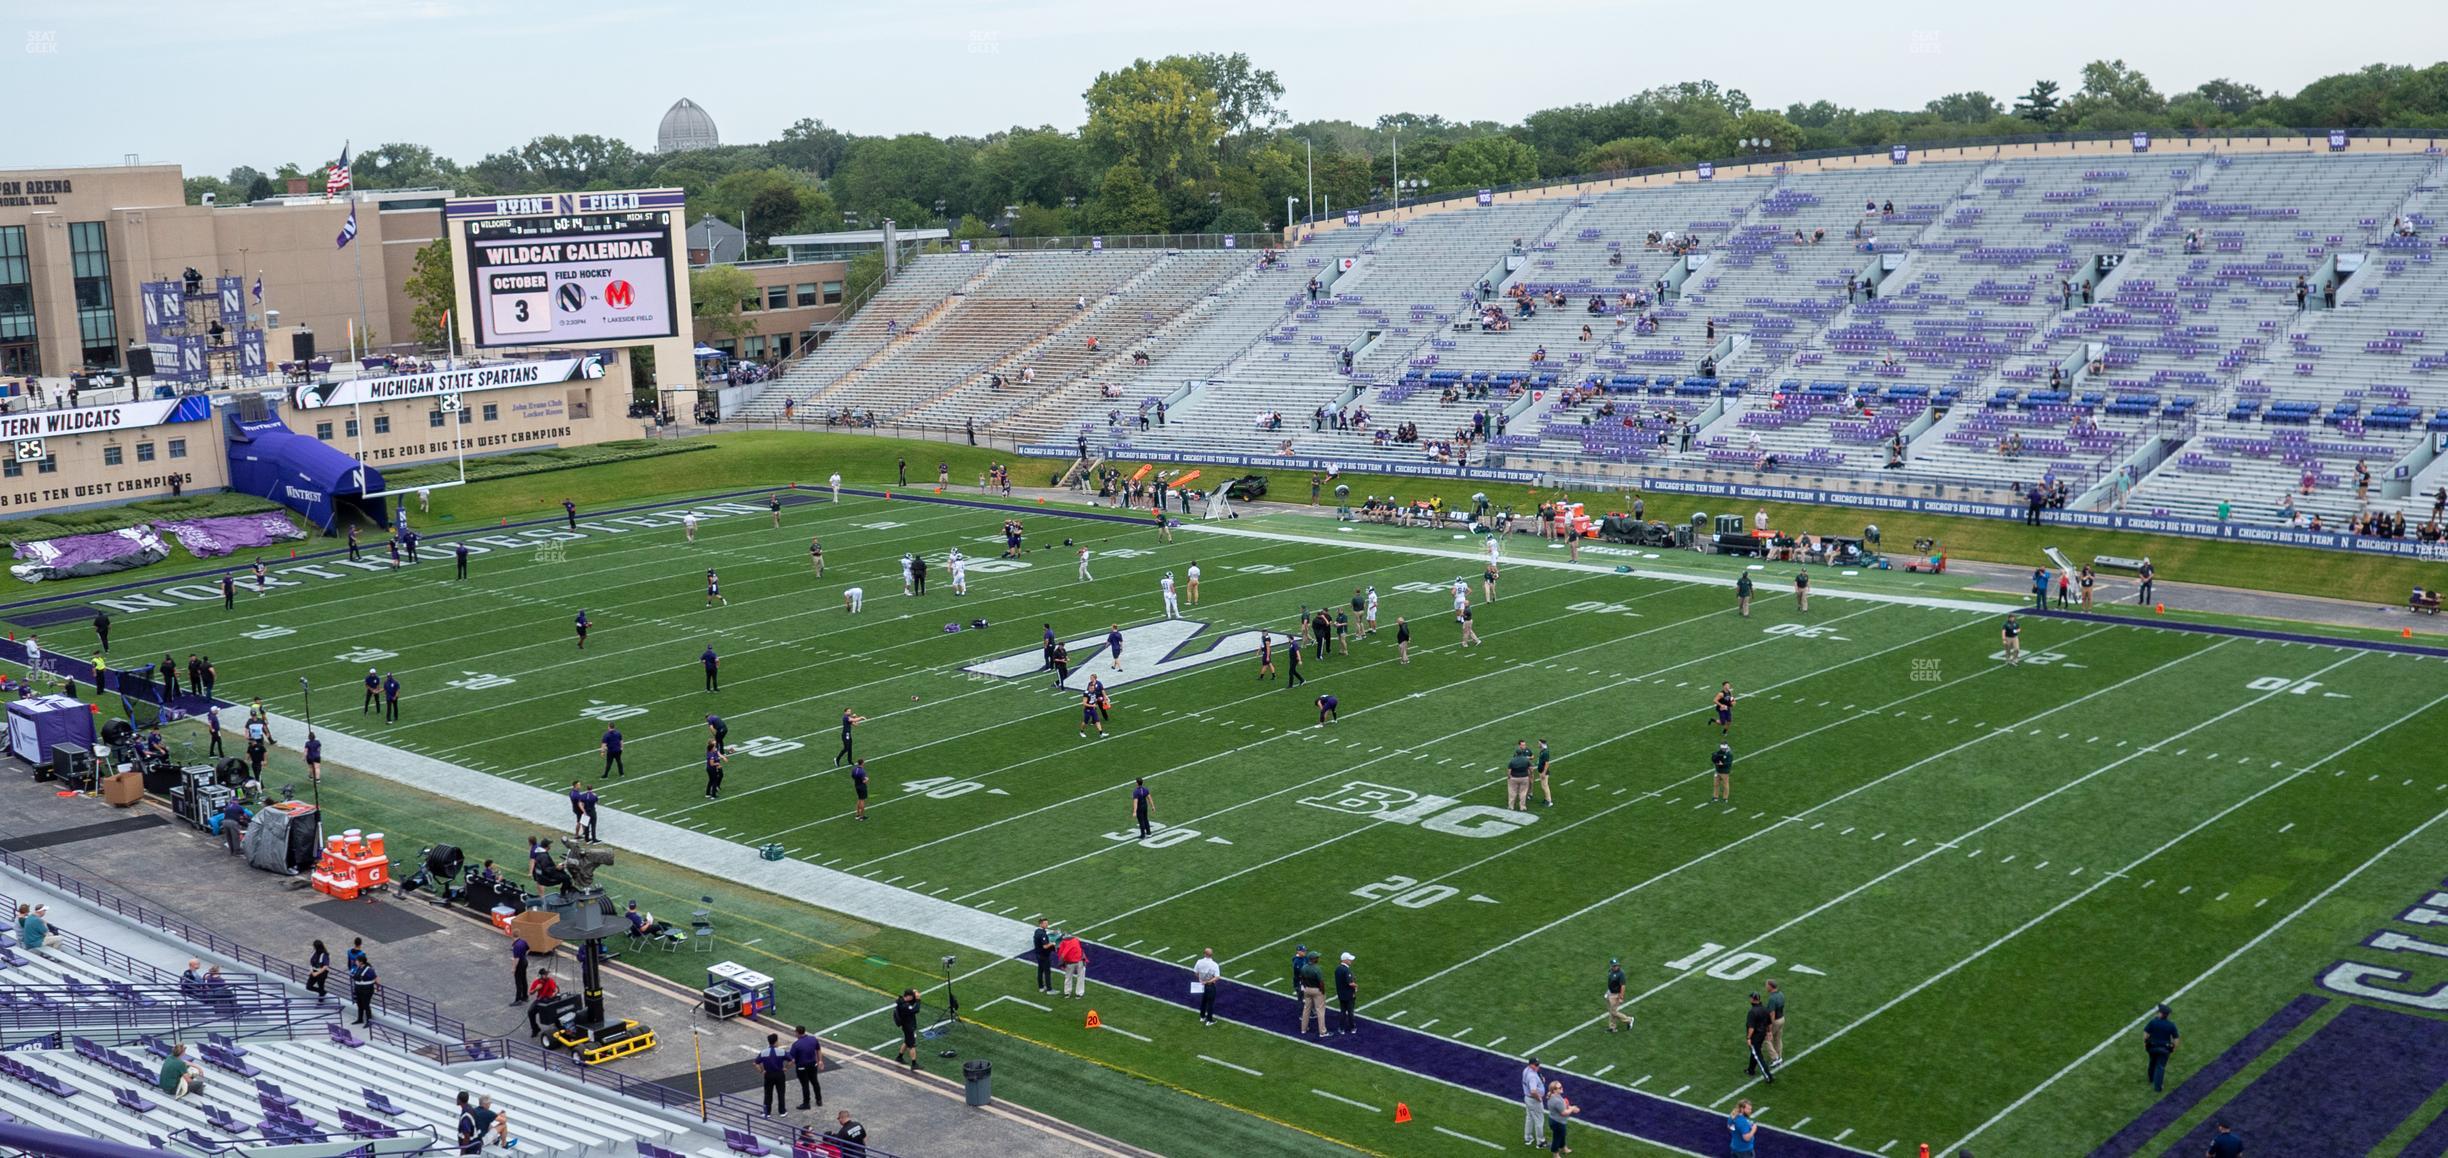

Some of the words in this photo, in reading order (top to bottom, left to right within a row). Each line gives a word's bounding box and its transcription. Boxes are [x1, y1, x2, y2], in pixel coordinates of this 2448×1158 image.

[26, 180, 72, 194] ARENA
[34, 196, 58, 205] HALL
[496, 198, 544, 216] RYAN
[560, 194, 574, 215] N
[589, 194, 640, 210] FIELD
[472, 223, 480, 234] 0
[480, 220, 511, 228] WILDCATS
[662, 213, 669, 224] 0
[486, 245, 562, 265] WILDCAT
[567, 240, 653, 260] CALENDAR
[494, 276, 546, 289] OCTOBER
[555, 271, 577, 280] FIELD
[580, 269, 612, 279] HOCKEY
[144, 293, 157, 325] N
[163, 293, 179, 316] N
[224, 289, 239, 312] N
[515, 300, 529, 322] 3
[185, 347, 201, 371] N
[245, 342, 261, 366] N
[371, 376, 434, 398] MICHIGAN
[439, 372, 473, 390] STATE
[479, 366, 538, 387] SPARTANS
[443, 395, 460, 410] 25
[512, 402, 526, 411] John
[1, 417, 40, 437] TERN
[47, 409, 120, 432] WILDCATS
[523, 409, 544, 418] Locker
[19, 442, 42, 458] 25
[373, 448, 395, 460] THE
[400, 444, 425, 456] 2018
[430, 442, 447, 452] BIG
[452, 438, 473, 450] TEN
[478, 434, 507, 446] WEST
[512, 426, 571, 442] CHAMPIONS
[1158, 452, 1171, 460] TEAM
[1395, 465, 1420, 474] CHICAGO'S
[1422, 466, 1430, 474] BIG
[1470, 470, 1496, 478] CHICAGO'S
[1, 496, 8, 506] 8
[15, 492, 37, 504] BIG
[43, 488, 69, 500] TEN
[75, 483, 112, 497] WEST
[1655, 481, 1684, 491] CHICAGO'S
[1685, 483, 1694, 491] BIG
[1696, 484, 1707, 492] TEN
[1708, 485, 1724, 493] TEAM
[1741, 487, 1770, 497] CHICAGO'S
[1772, 489, 1782, 498] BIG
[1784, 490, 1795, 498] TEN
[1797, 491, 1814, 500] TEAM
[1831, 494, 1862, 504] CHICAGO'S
[1863, 496, 1874, 505] BIG
[1876, 497, 1888, 506] TEN
[1890, 498, 1907, 508] TEAM
[1925, 502, 1957, 512] CHICAGO'S
[1959, 504, 1970, 513] BIG
[1972, 506, 1984, 514] TEN
[1986, 507, 2005, 516] TEAM
[2060, 512, 2072, 522] BIG
[2074, 514, 2087, 523] TEN
[2089, 515, 2108, 524] TEAM
[2128, 518, 2165, 530] CHICAGO'S
[2167, 521, 2179, 531] BIG
[2181, 522, 2195, 532] TEN
[2197, 524, 2217, 534] TEAM
[2239, 528, 2278, 540] CHICAGO'S
[2279, 531, 2292, 542] BIG
[2294, 532, 2310, 543] TEN
[2312, 534, 2334, 546] TEAM
[2356, 538, 2398, 551] CHICAGO'S
[2401, 542, 2414, 553] BIG
[2416, 544, 2432, 554] TEN
[96, 501, 757, 614] NORTHWESTERN
[1565, 602, 1632, 613] 40
[1765, 623, 1837, 637] 30
[444, 674, 516, 690] 30
[2246, 677, 2323, 694] 10
[580, 704, 650, 720] 40
[724, 736, 805, 757] 50
[901, 776, 986, 798] 40
[1102, 821, 1202, 848] 30
[370, 868, 379, 880] G
[1350, 875, 1460, 908] 20
[1664, 942, 1777, 980] 10
[1088, 1016, 1098, 1025] 20
[1399, 1109, 1407, 1117] 10
